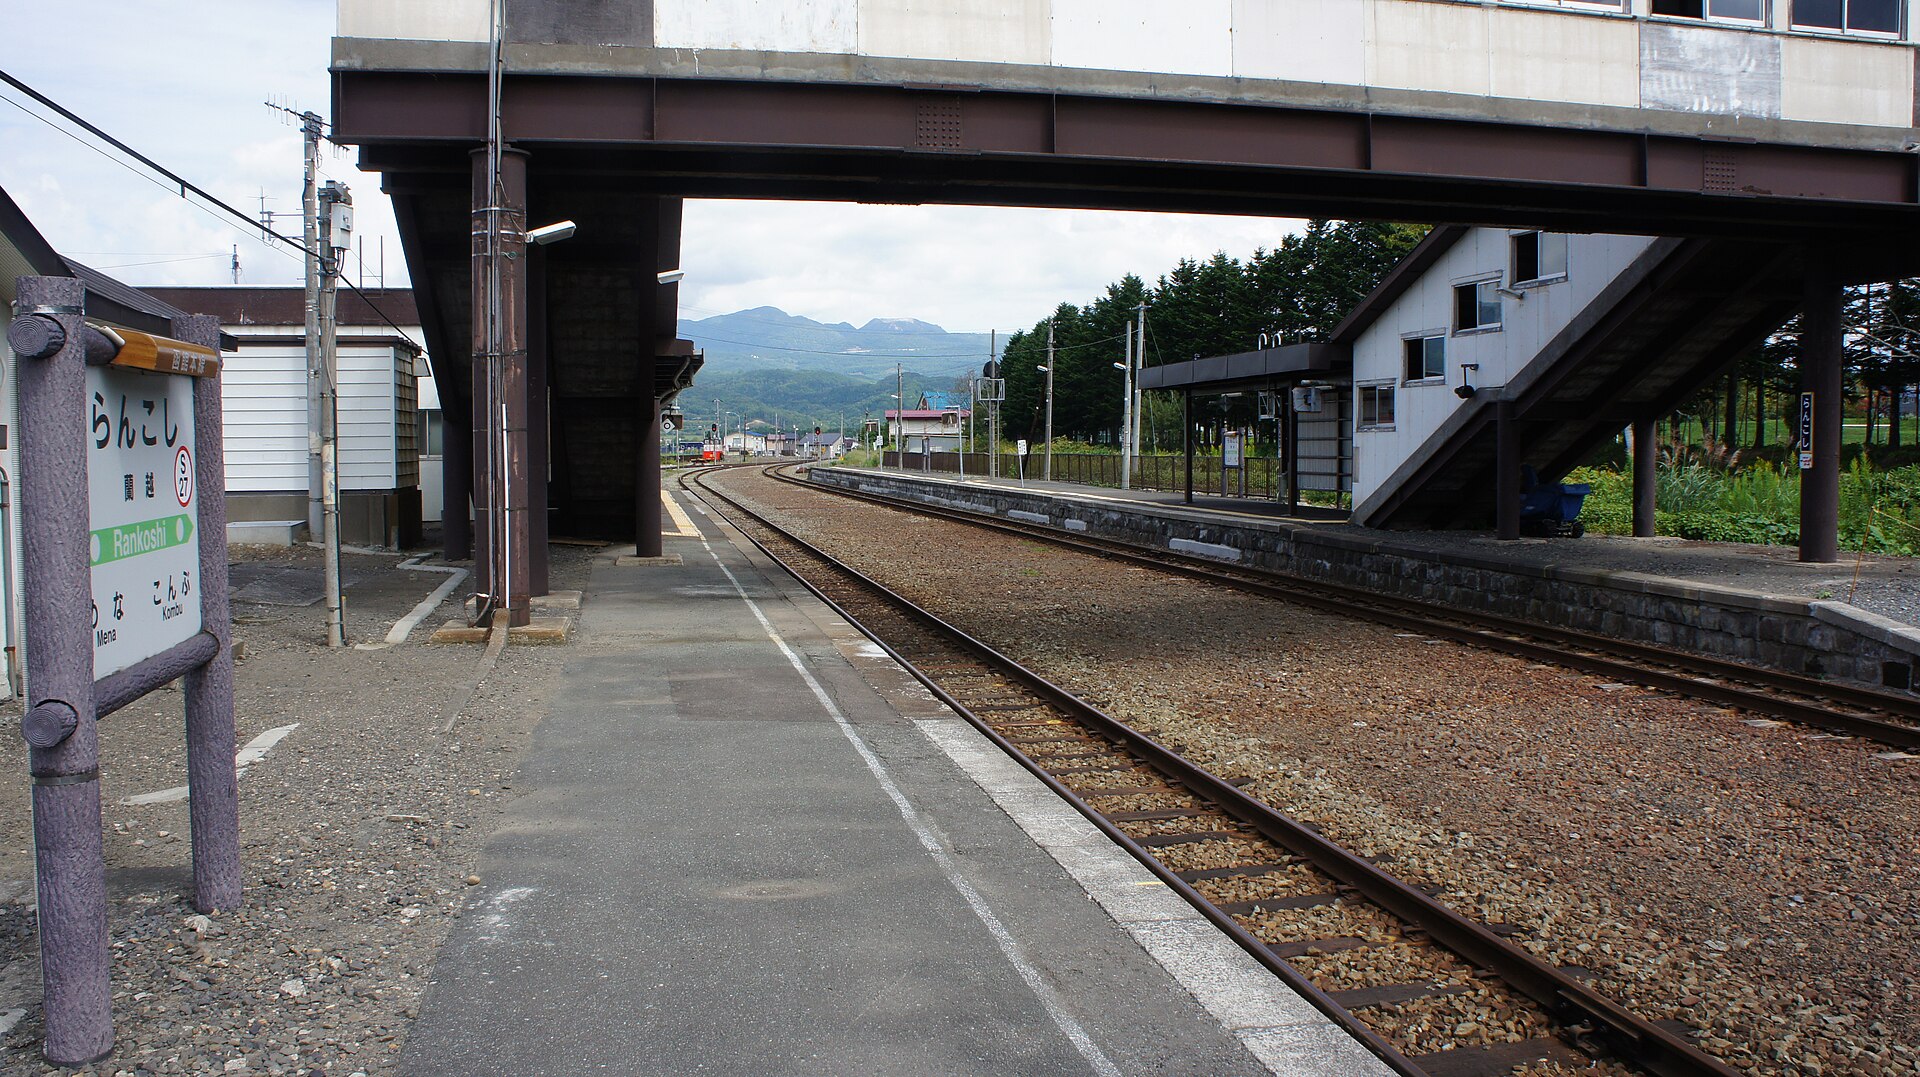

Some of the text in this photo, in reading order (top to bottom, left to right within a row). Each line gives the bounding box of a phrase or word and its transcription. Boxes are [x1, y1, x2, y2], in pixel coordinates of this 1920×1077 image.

[92, 391, 178, 449] らんこし
[1802, 397, 1810, 448] らんこし
[180, 453, 187, 475] S
[124, 471, 155, 502] 蘭越
[179, 477, 188, 498] 27
[113, 520, 167, 558] Rankoshi
[153, 571, 191, 606] こんぶ
[162, 602, 183, 621] Kombu
[96, 628, 117, 647] Mena
